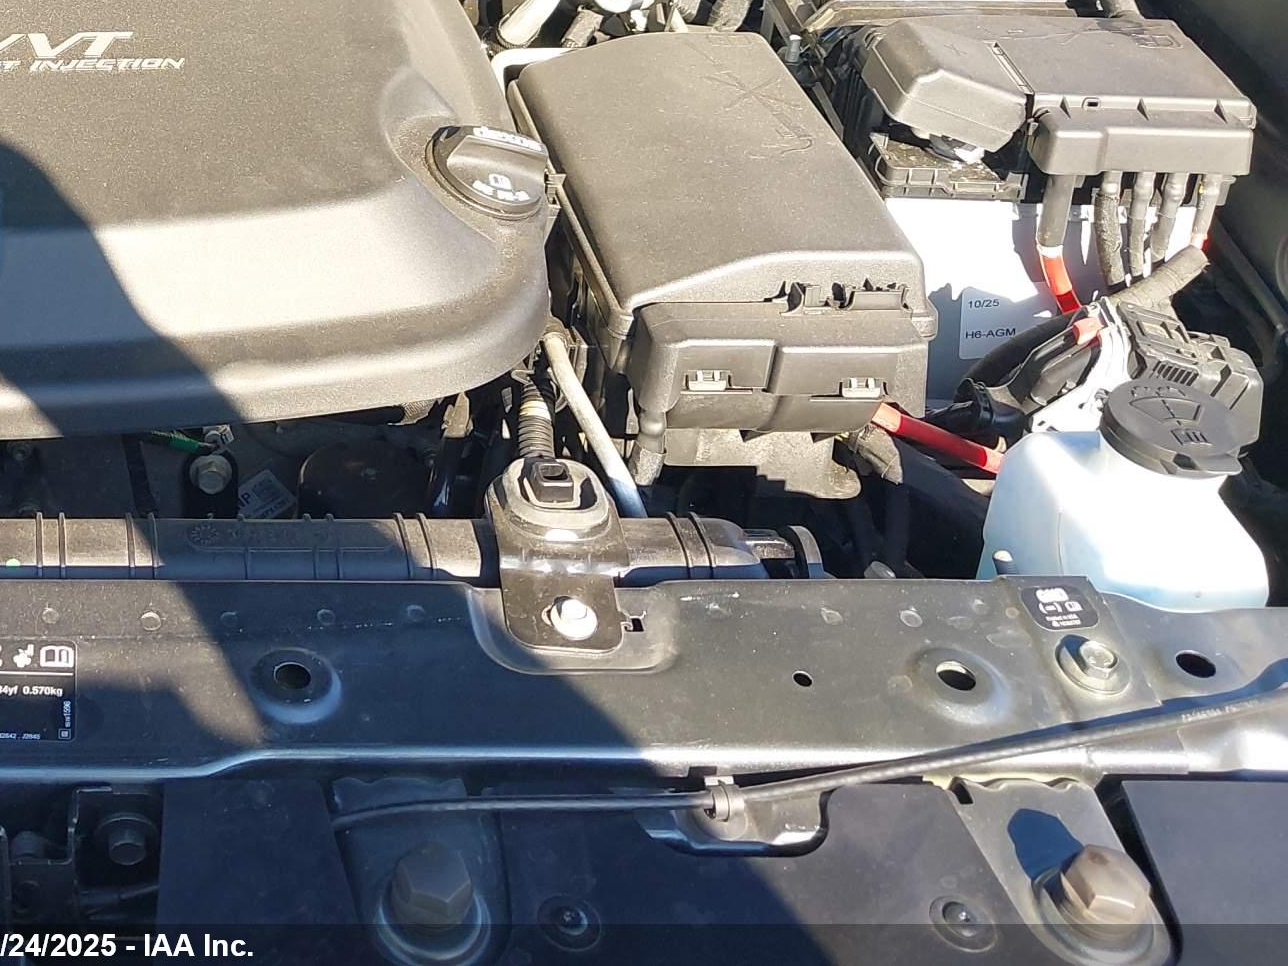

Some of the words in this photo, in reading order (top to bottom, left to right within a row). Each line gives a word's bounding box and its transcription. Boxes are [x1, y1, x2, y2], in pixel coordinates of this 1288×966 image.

[28, 57, 185, 73] INJECTION
[968, 299, 1000, 309] 10/25
[965, 328, 1016, 339] H6-AGM
[23, 686, 63, 697] 0.570kg
